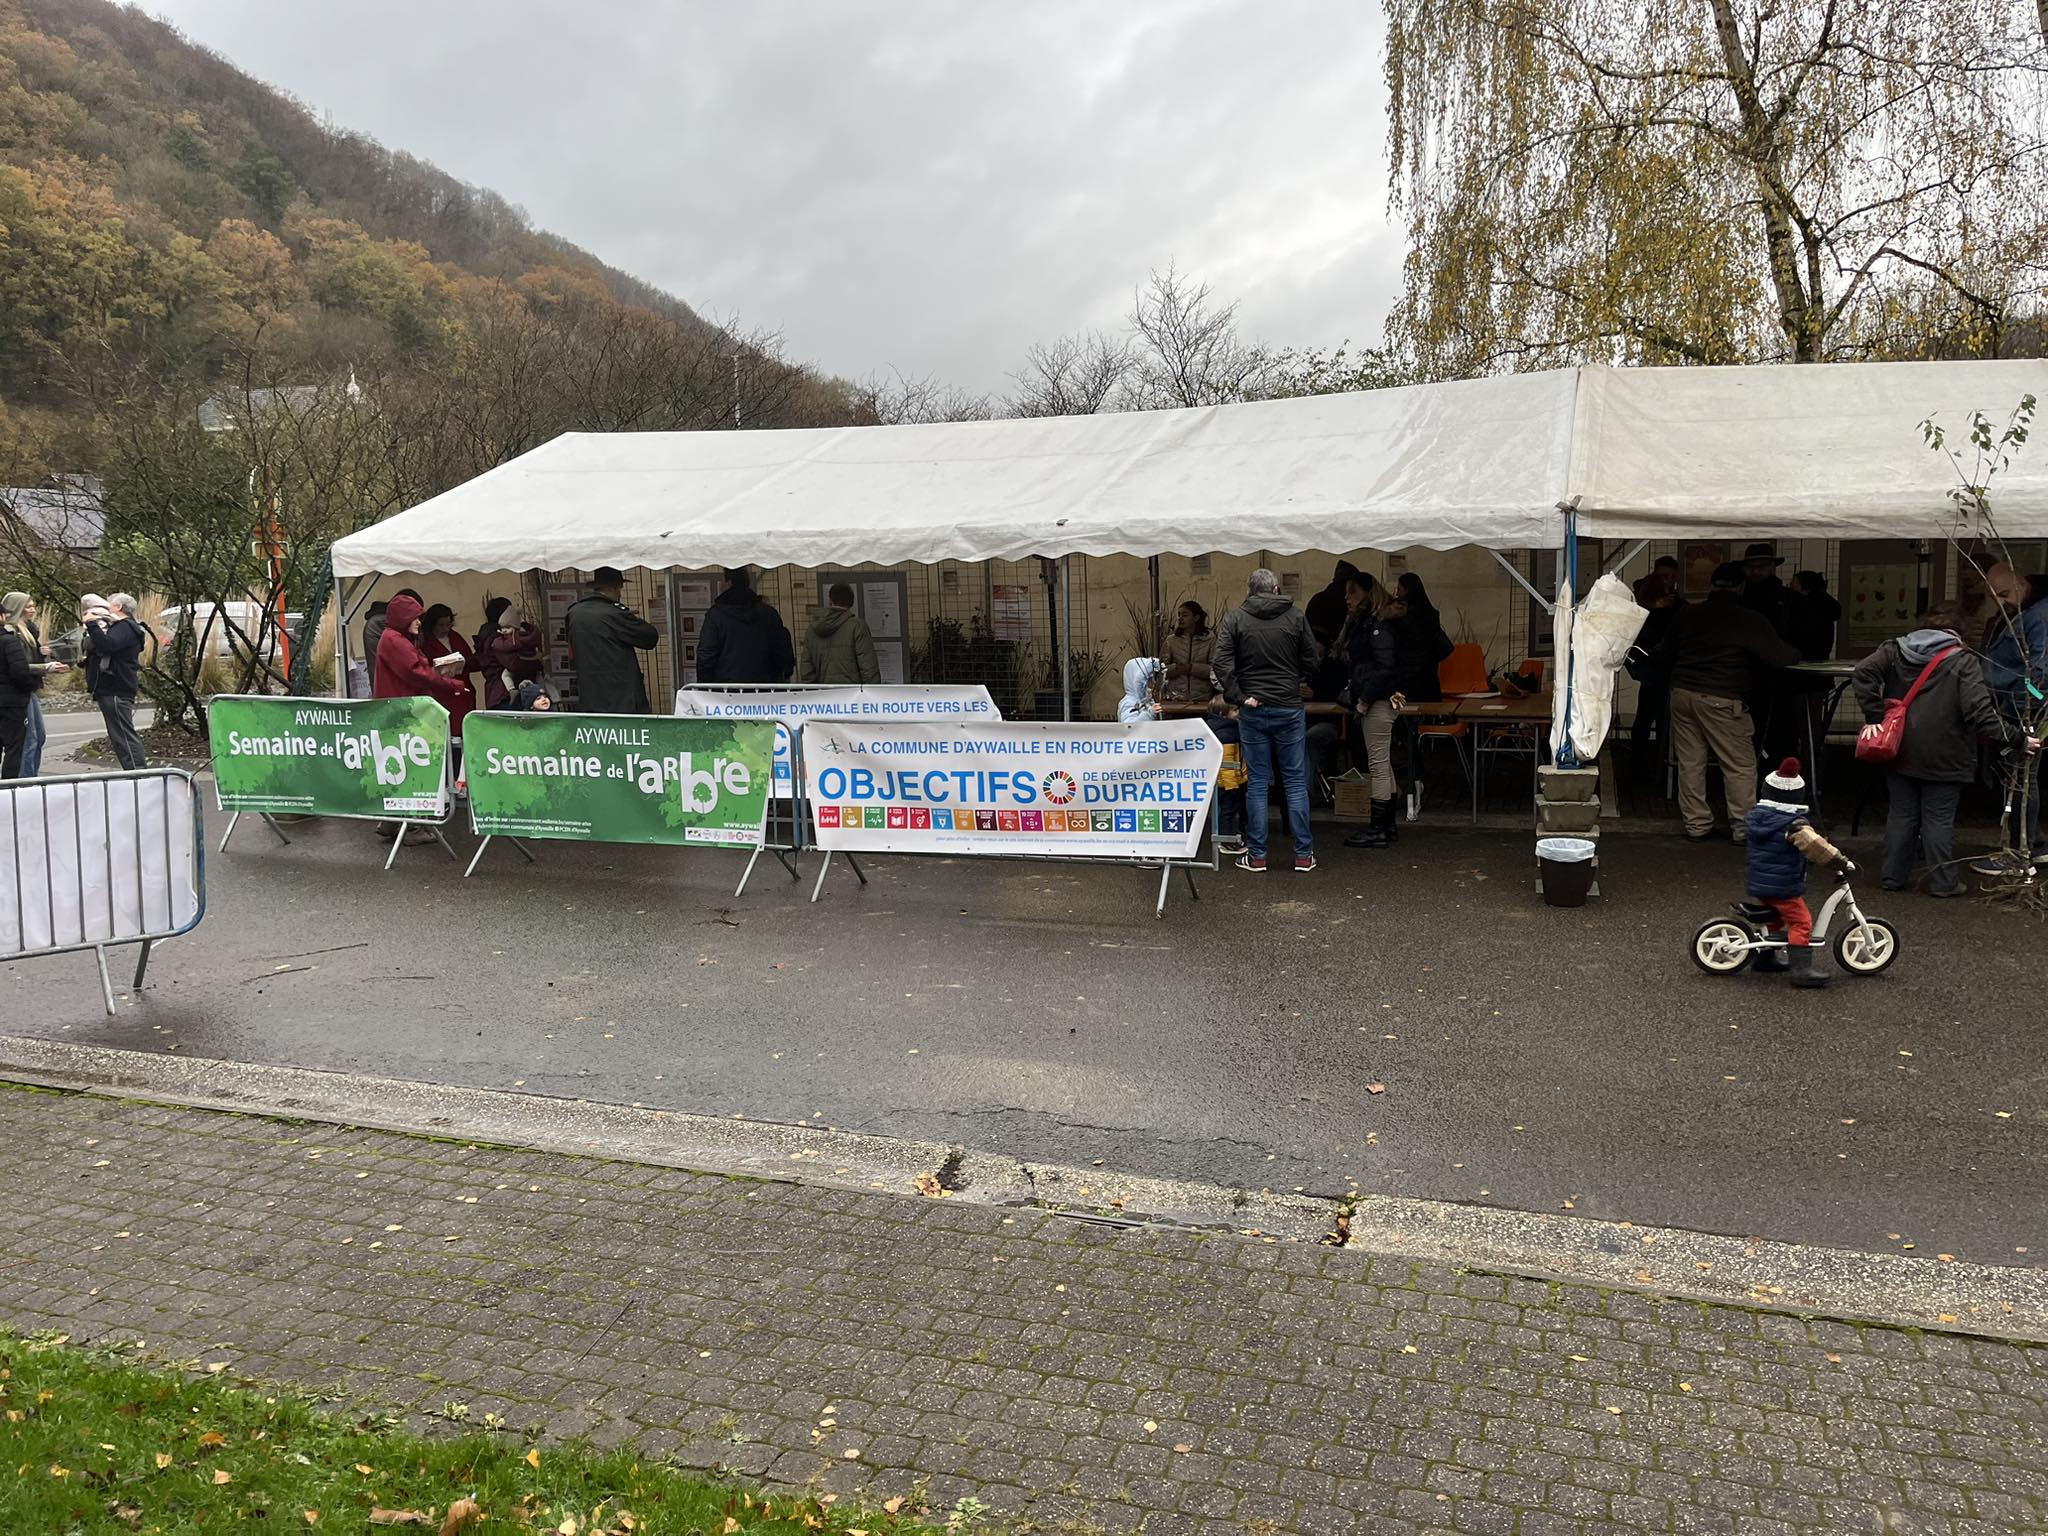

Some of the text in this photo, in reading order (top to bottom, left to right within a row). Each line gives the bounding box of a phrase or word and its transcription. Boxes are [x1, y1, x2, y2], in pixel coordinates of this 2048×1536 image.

[295, 709, 352, 726] AYWAILLE
[705, 700, 988, 717] LA COMMUNE D'AYWAILLE EN ROUTE VERS LES
[229, 730, 317, 756] Semaine
[320, 742, 334, 756] de
[575, 728, 650, 746] AYWAILLE
[849, 738, 1206, 754] LA COMMUNE D'AYWAILLE EN ROUTE VERS LES
[486, 748, 601, 778] Semaine
[607, 763, 624, 779] de
[1083, 768, 1207, 781] DE DÉVELOPPEMENT
[818, 767, 1037, 804] OBJECTIFS
[1083, 782, 1207, 803] DURABLE
